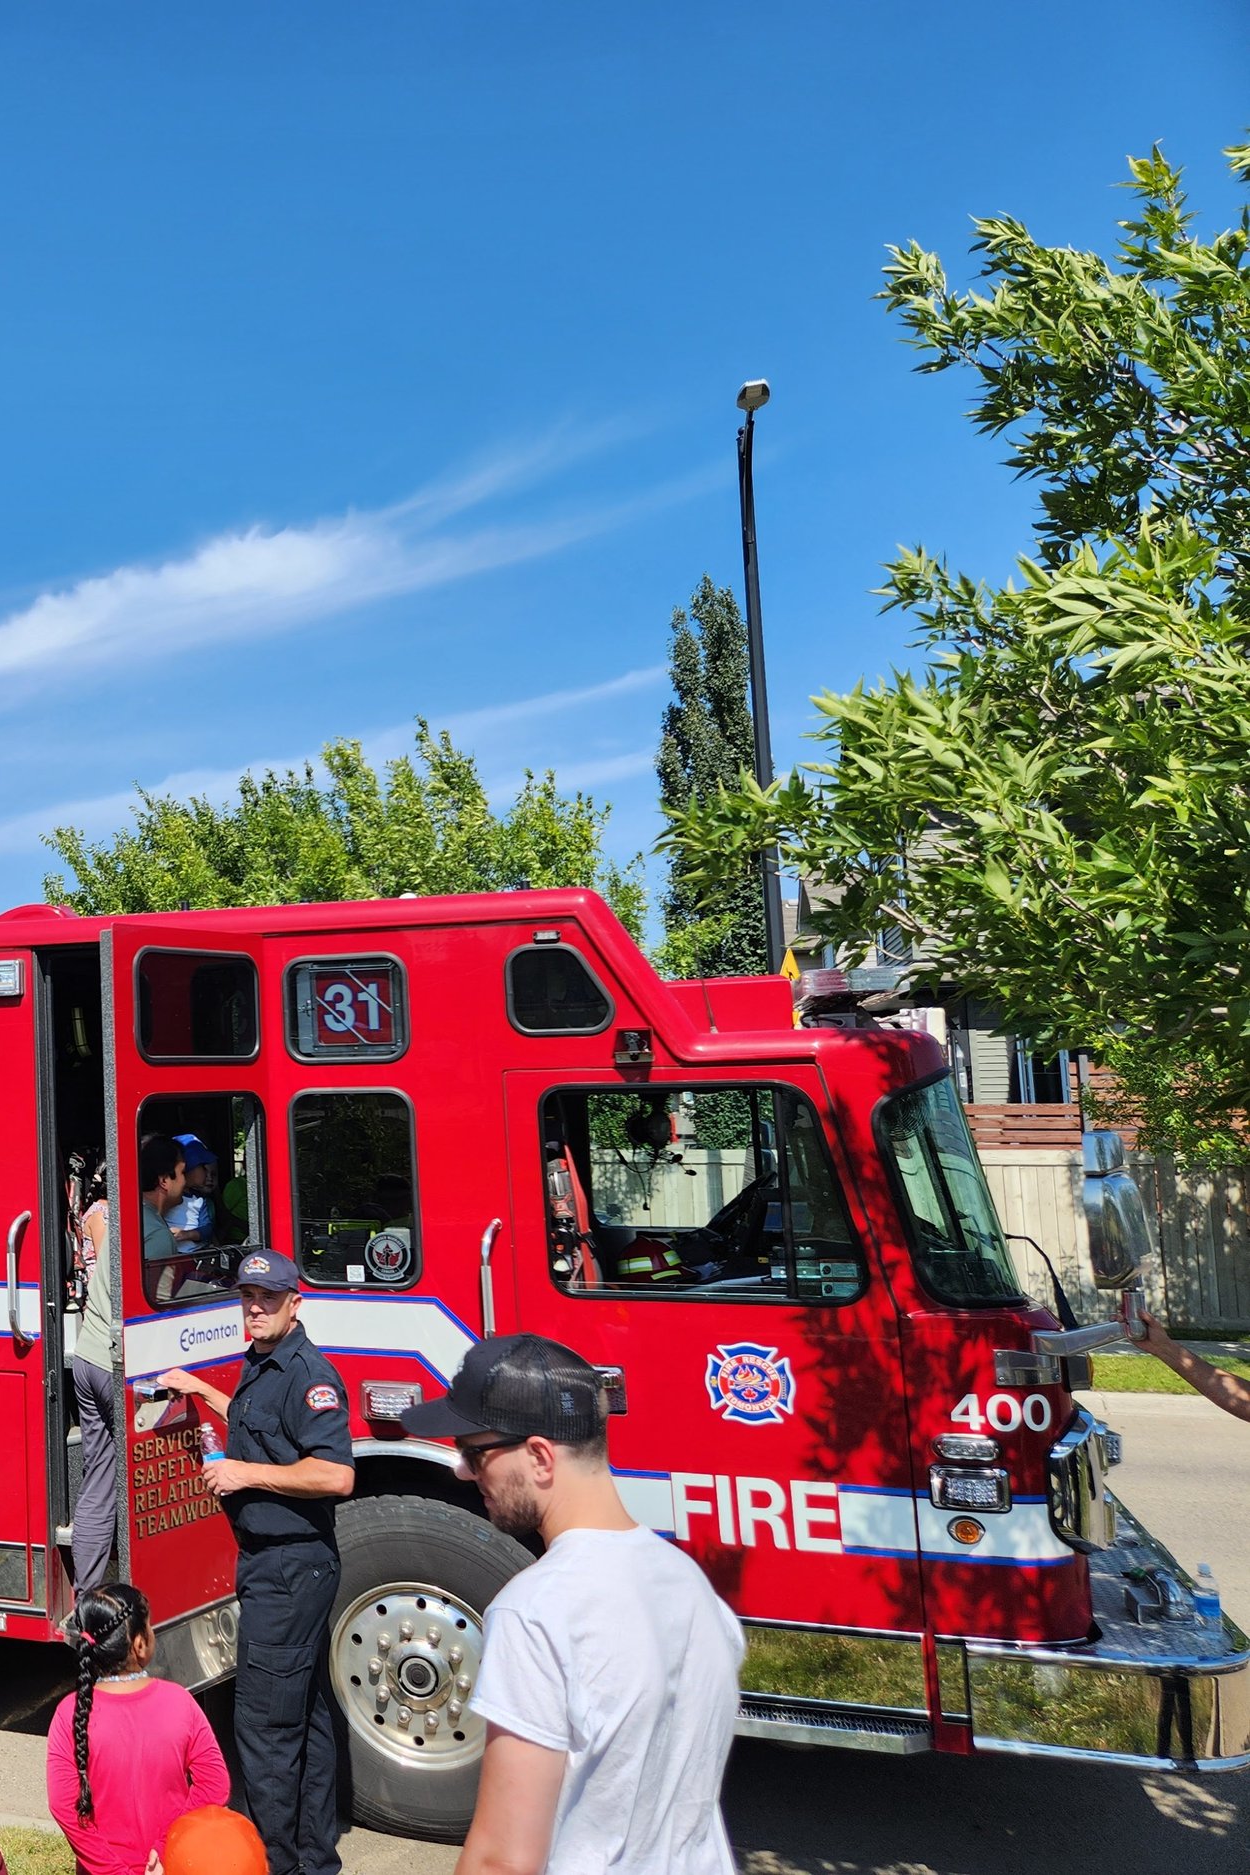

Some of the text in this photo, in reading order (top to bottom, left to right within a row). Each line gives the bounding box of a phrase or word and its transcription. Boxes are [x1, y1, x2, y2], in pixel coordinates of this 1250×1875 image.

[324, 983, 380, 1032] 31
[180, 1324, 238, 1352] Edmonton
[720, 1356, 778, 1380] FIRE RESCUE
[725, 1393, 777, 1411] EDMONTON
[950, 1393, 1051, 1432] 400
[133, 1428, 202, 1463] SERVICE
[133, 1452, 199, 1488] SAFETY
[134, 1476, 207, 1514] RELATIO
[670, 1471, 843, 1554] FIRE
[135, 1496, 223, 1539] TEAMWOR
